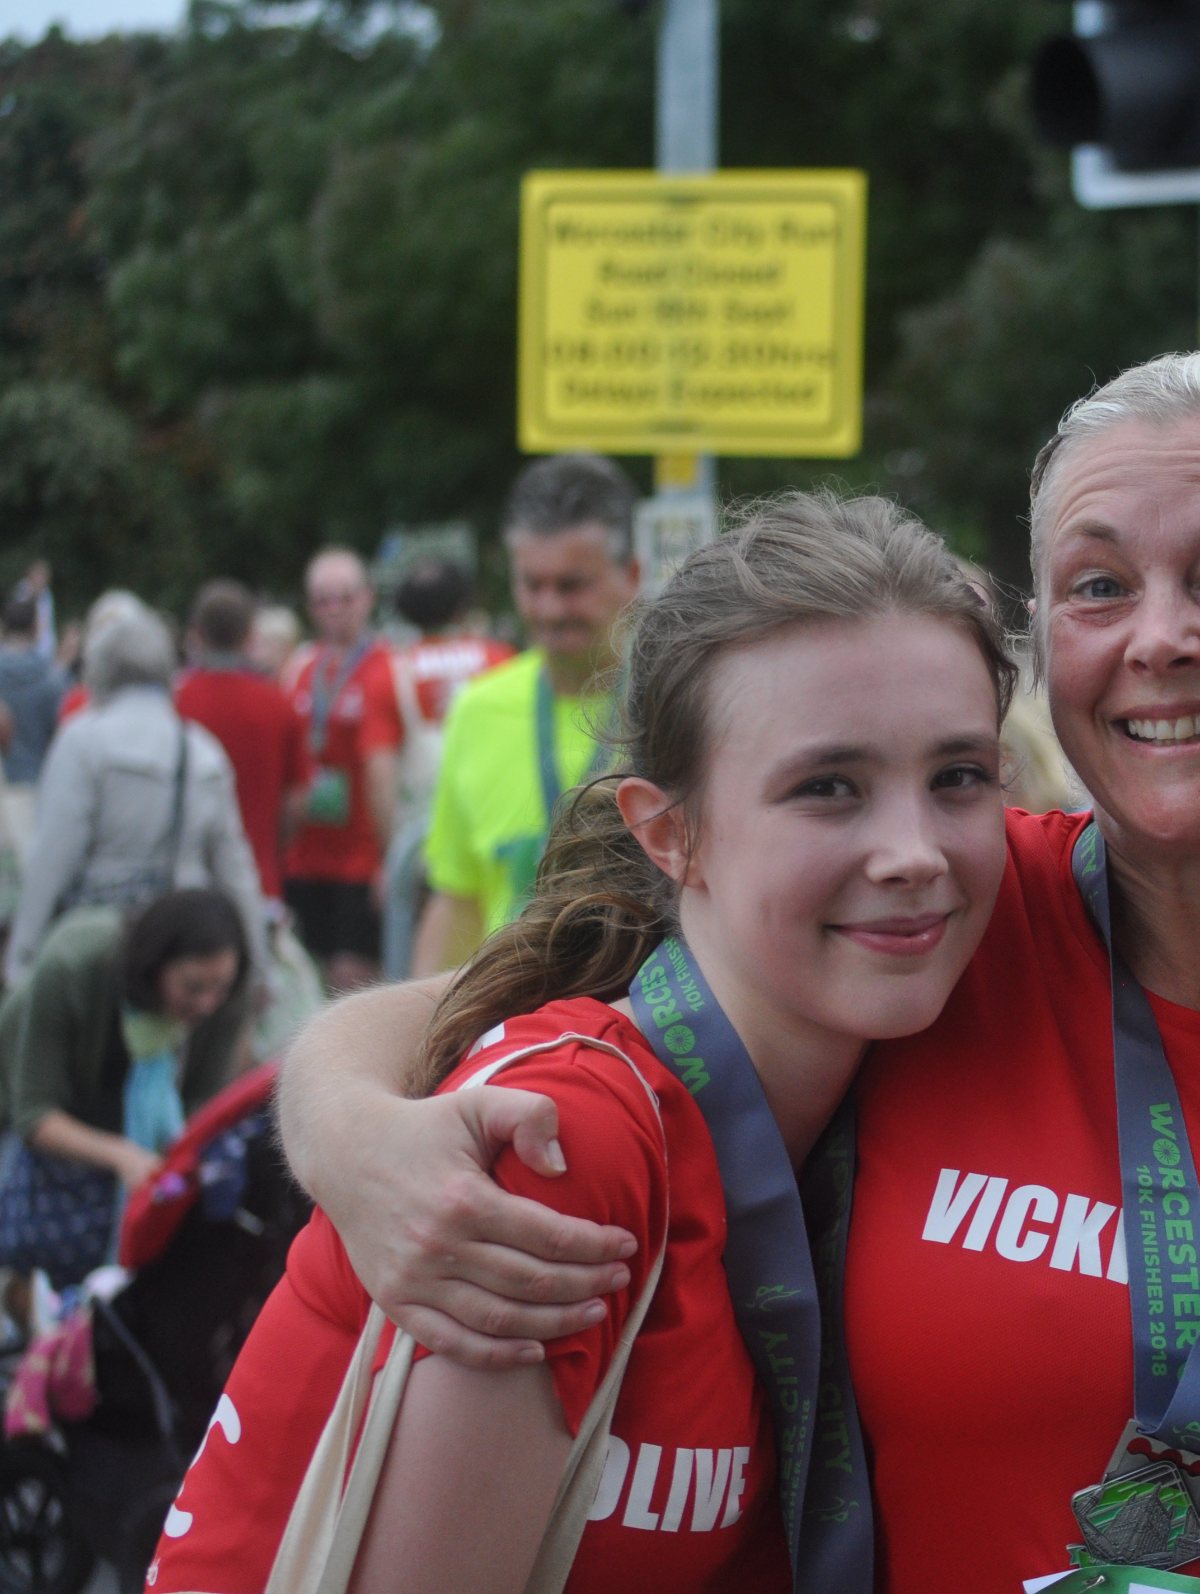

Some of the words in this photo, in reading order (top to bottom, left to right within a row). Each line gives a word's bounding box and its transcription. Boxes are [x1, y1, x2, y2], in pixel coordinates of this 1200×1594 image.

[1136, 1165, 1154, 1204] 10K
[1139, 1209, 1165, 1315] FINISHER
[1149, 1322, 1168, 1377] 2018
